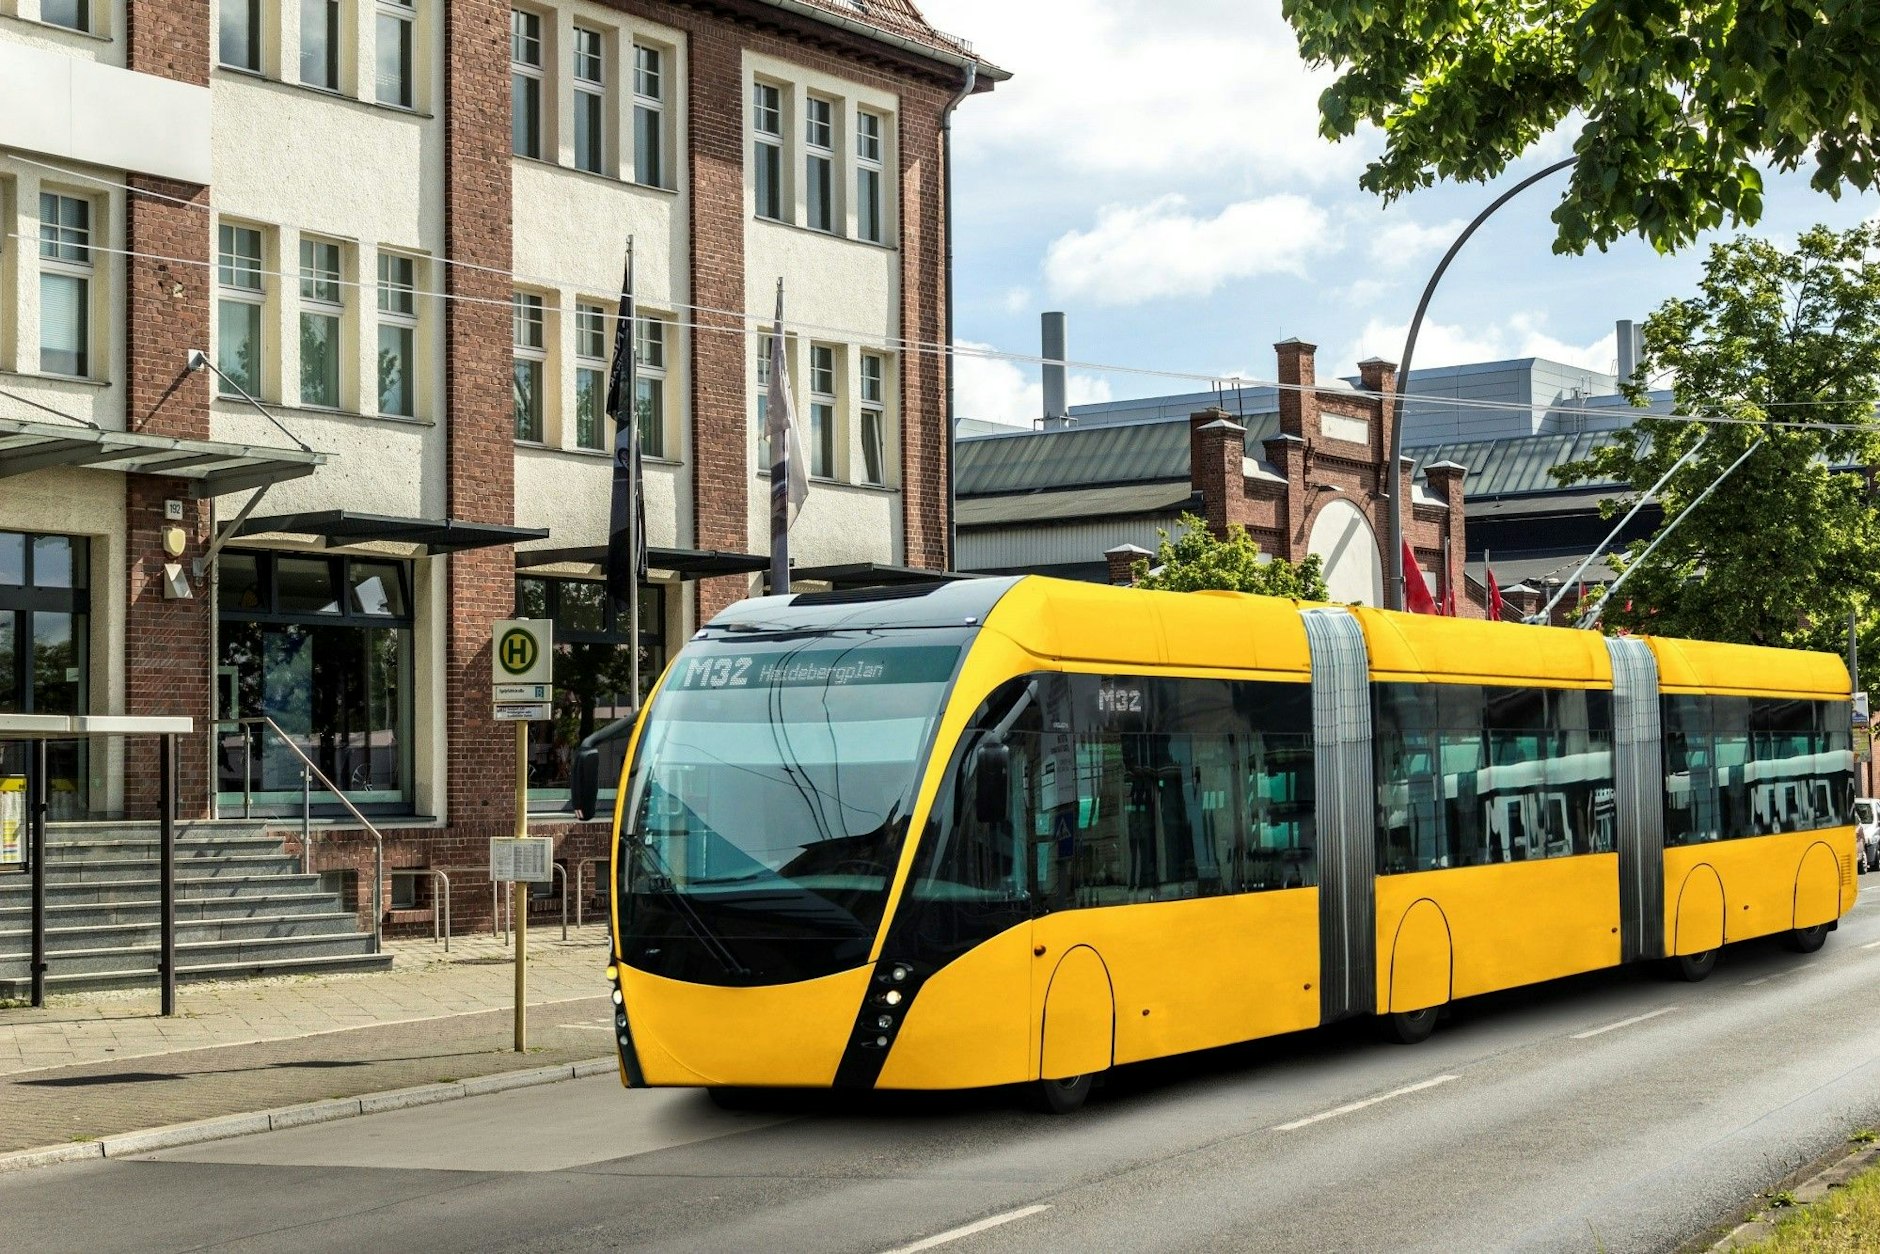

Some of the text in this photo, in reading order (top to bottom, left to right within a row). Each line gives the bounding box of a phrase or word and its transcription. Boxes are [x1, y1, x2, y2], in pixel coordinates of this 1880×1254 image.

[169, 503, 181, 514] 192
[507, 638, 527, 664] H
[683, 657, 753, 687] M32
[1098, 689, 1142, 712] M32
